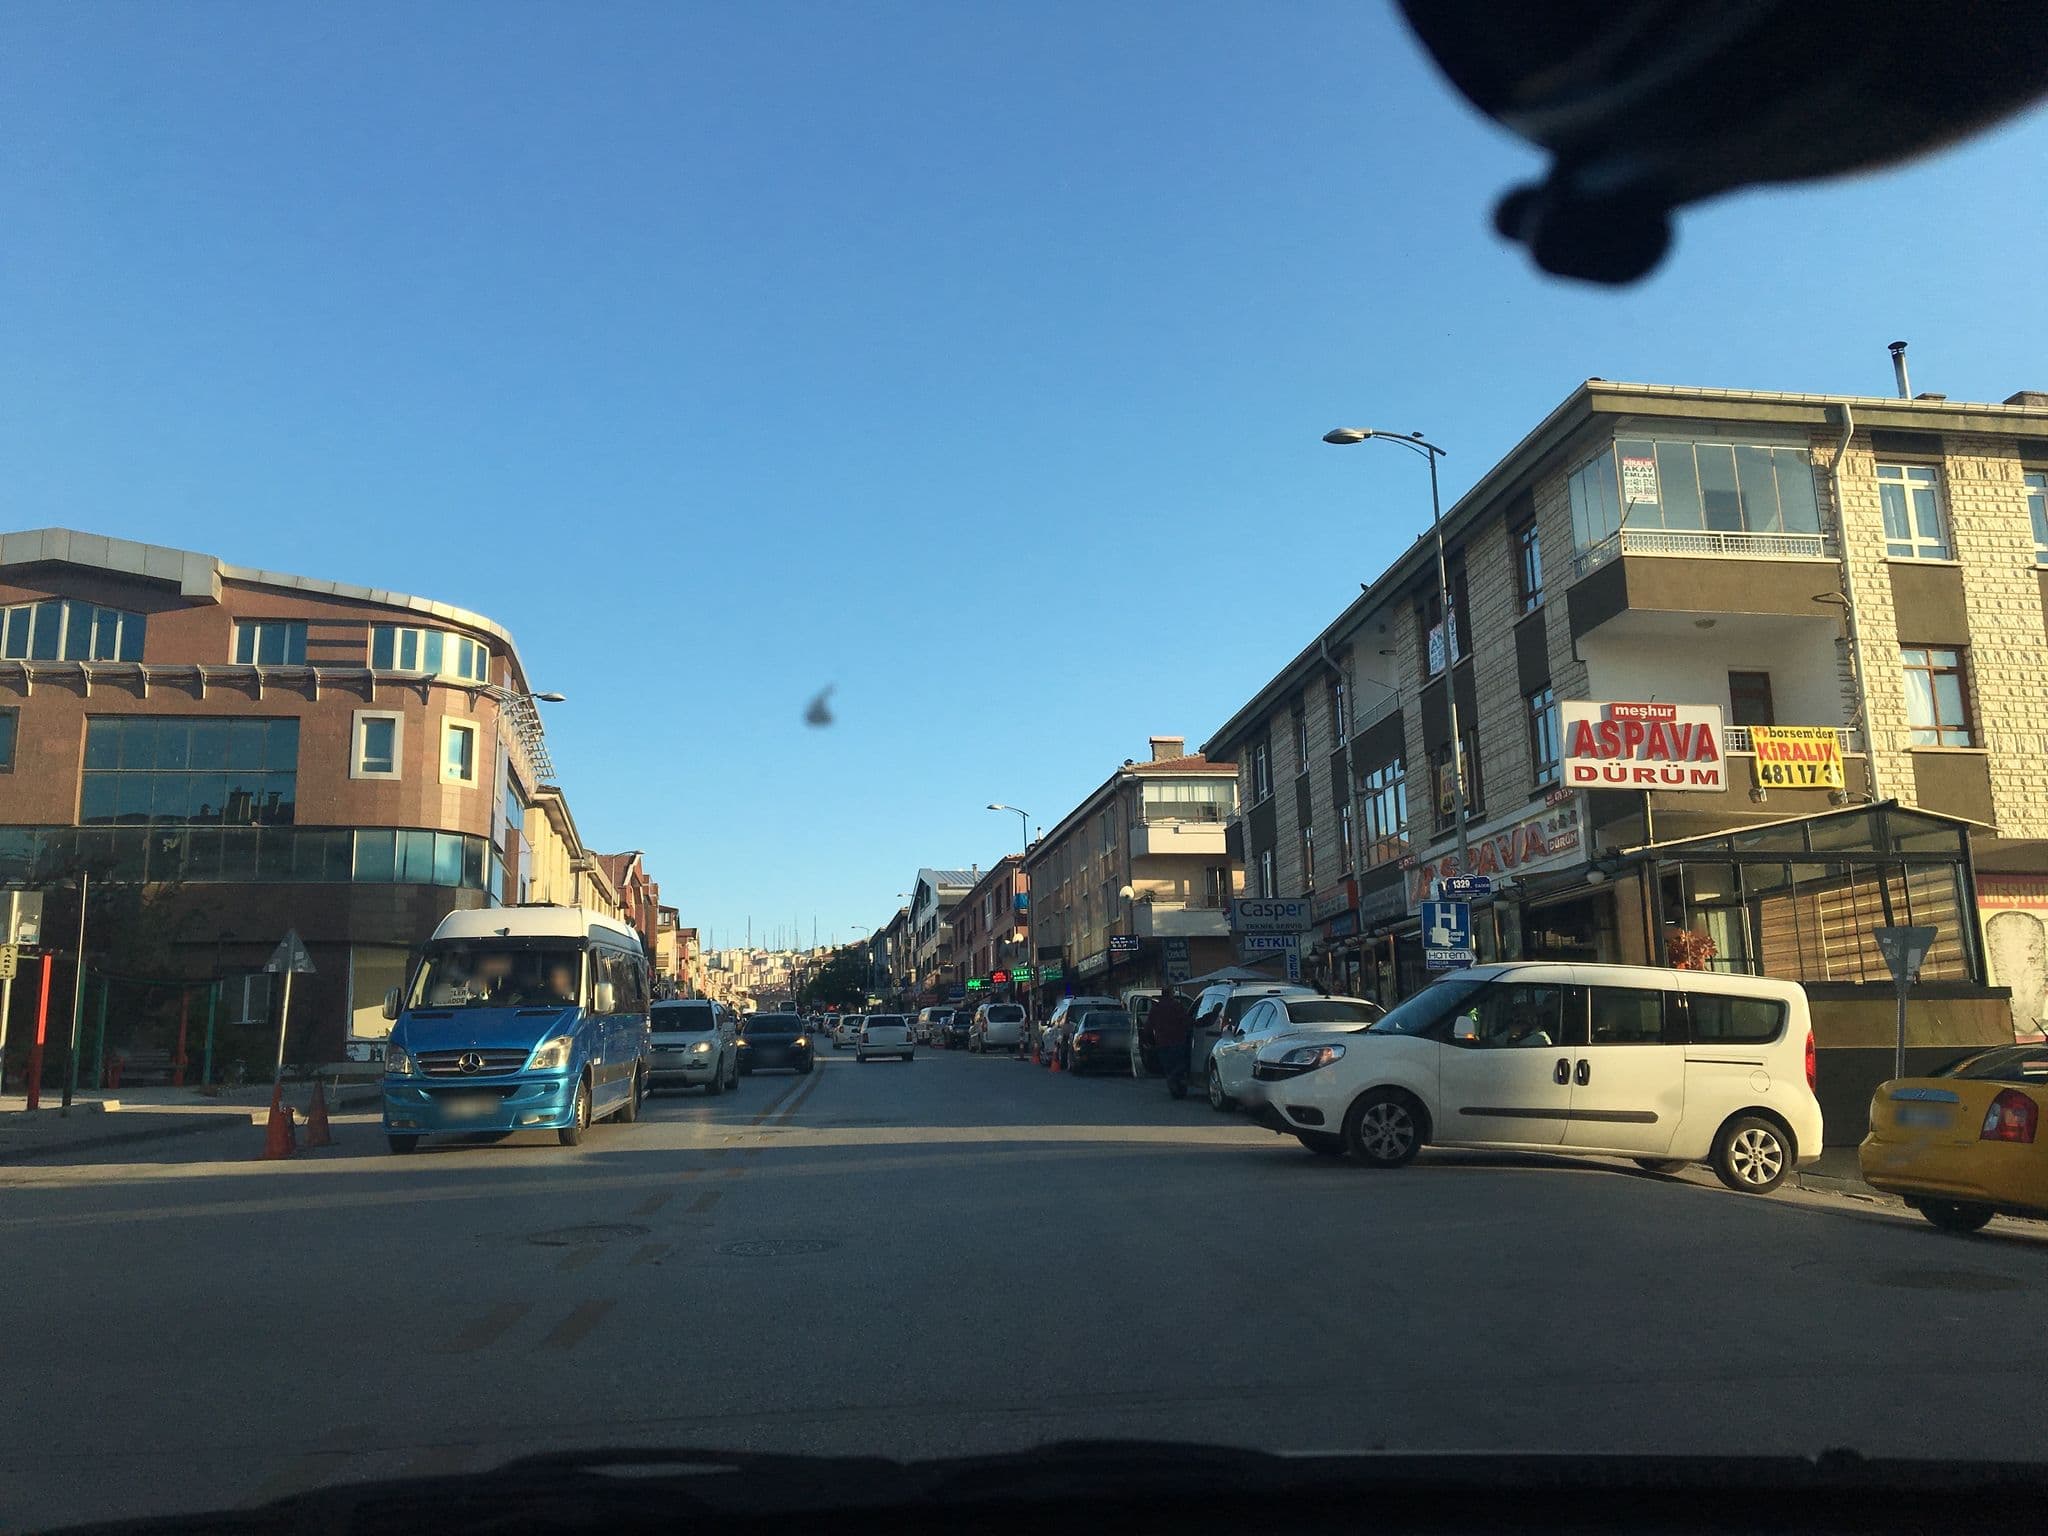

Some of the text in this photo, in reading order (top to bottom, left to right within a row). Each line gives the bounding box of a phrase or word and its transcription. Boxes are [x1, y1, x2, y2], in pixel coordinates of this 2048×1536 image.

[1615, 705, 1674, 719] meşhur
[1565, 720, 1719, 762] ASPAVA
[1574, 762, 1719, 785] DÜRÜM
[1240, 901, 1305, 920] Casper
